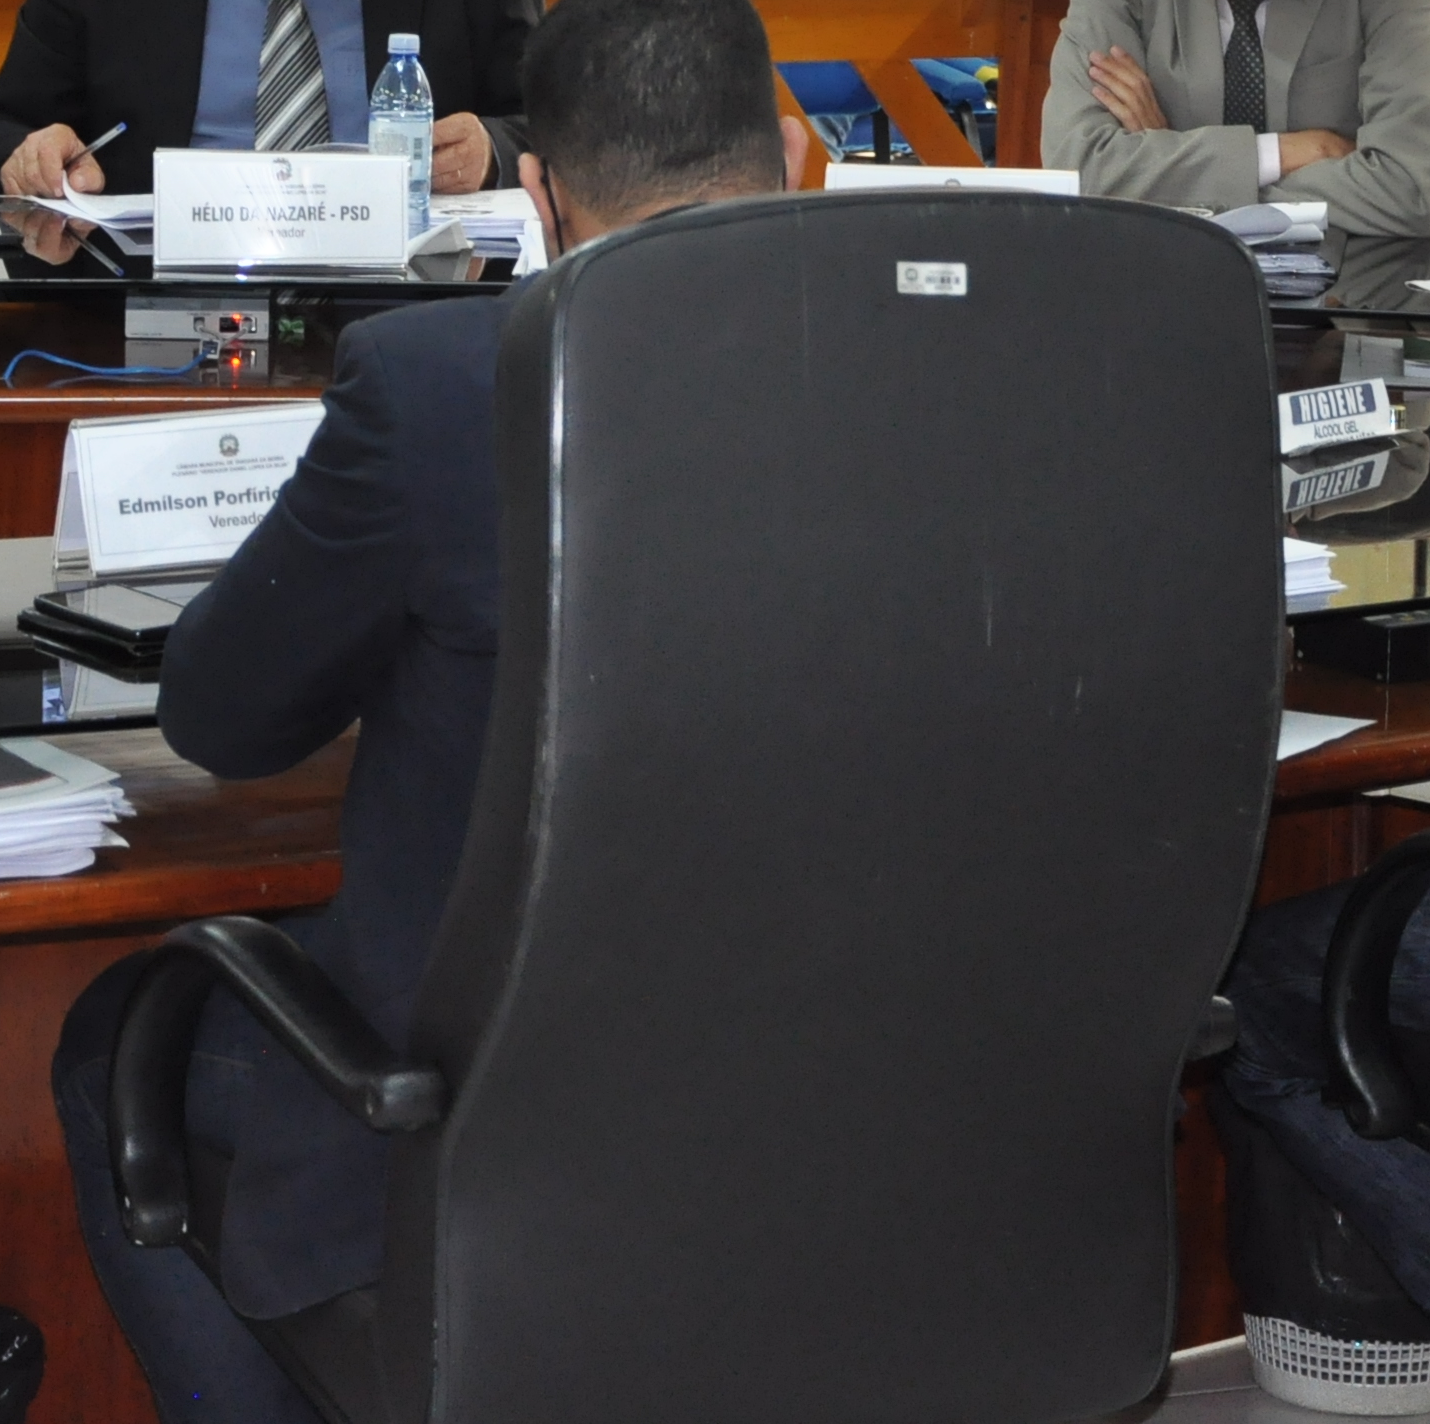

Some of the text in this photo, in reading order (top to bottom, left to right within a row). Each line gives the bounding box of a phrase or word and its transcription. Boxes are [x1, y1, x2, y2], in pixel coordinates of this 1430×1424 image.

[192, 202, 234, 222] HÉLIO
[267, 201, 326, 222] NAZARÉ
[341, 206, 370, 221] PSD
[1299, 386, 1367, 422] HIGIENE
